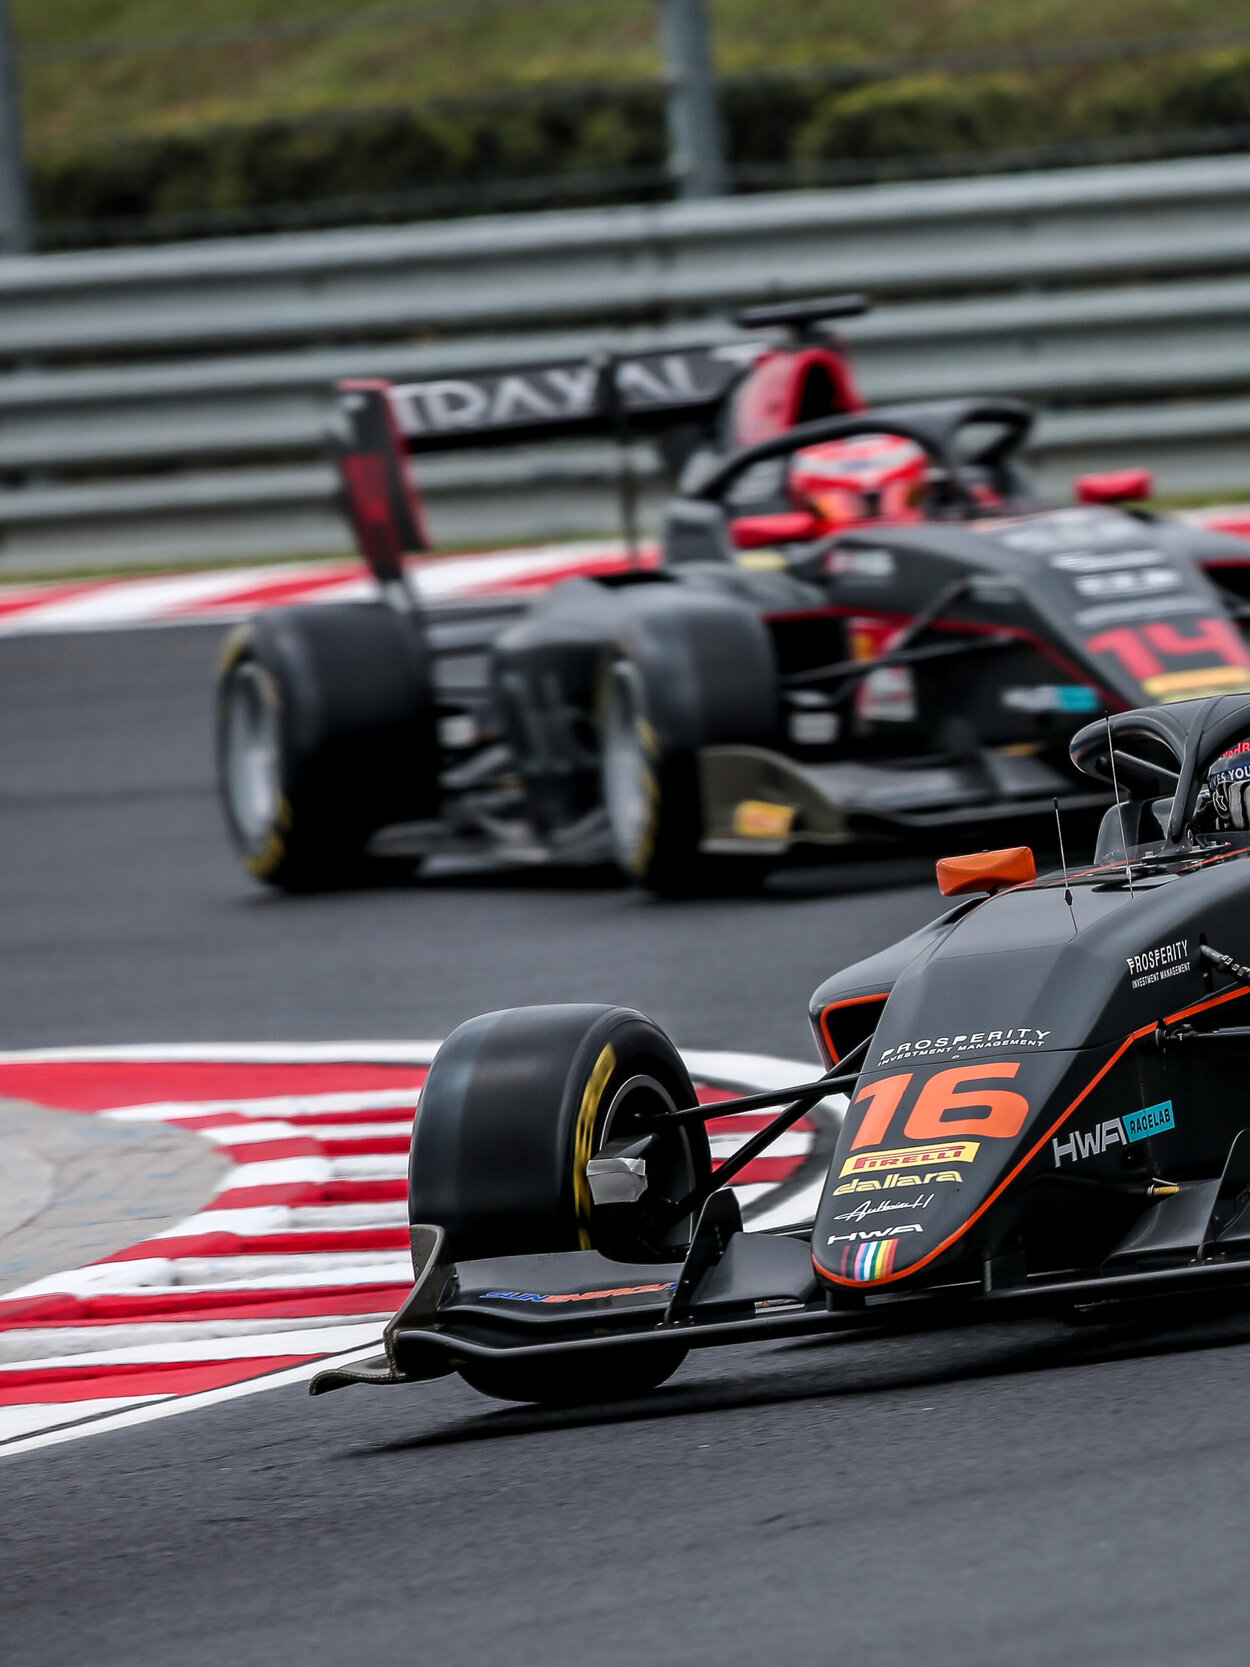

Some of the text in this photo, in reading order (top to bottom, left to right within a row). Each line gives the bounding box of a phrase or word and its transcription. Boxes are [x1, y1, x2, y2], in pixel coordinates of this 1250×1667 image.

[1126, 939, 1188, 975] PROSPERITY
[1132, 962, 1191, 989] INVESTMENT MANAGEMENT
[877, 1038, 1045, 1067] INVESTMENT MANAGEMENT
[880, 1028, 1051, 1060] PROSPERITY
[850, 1062, 1030, 1151] 16
[1052, 1108, 1171, 1168] HWA RACELAB
[852, 1145, 966, 1171] PIRELLI
[833, 1170, 963, 1196] dallara
[827, 1223, 924, 1246] HWA
